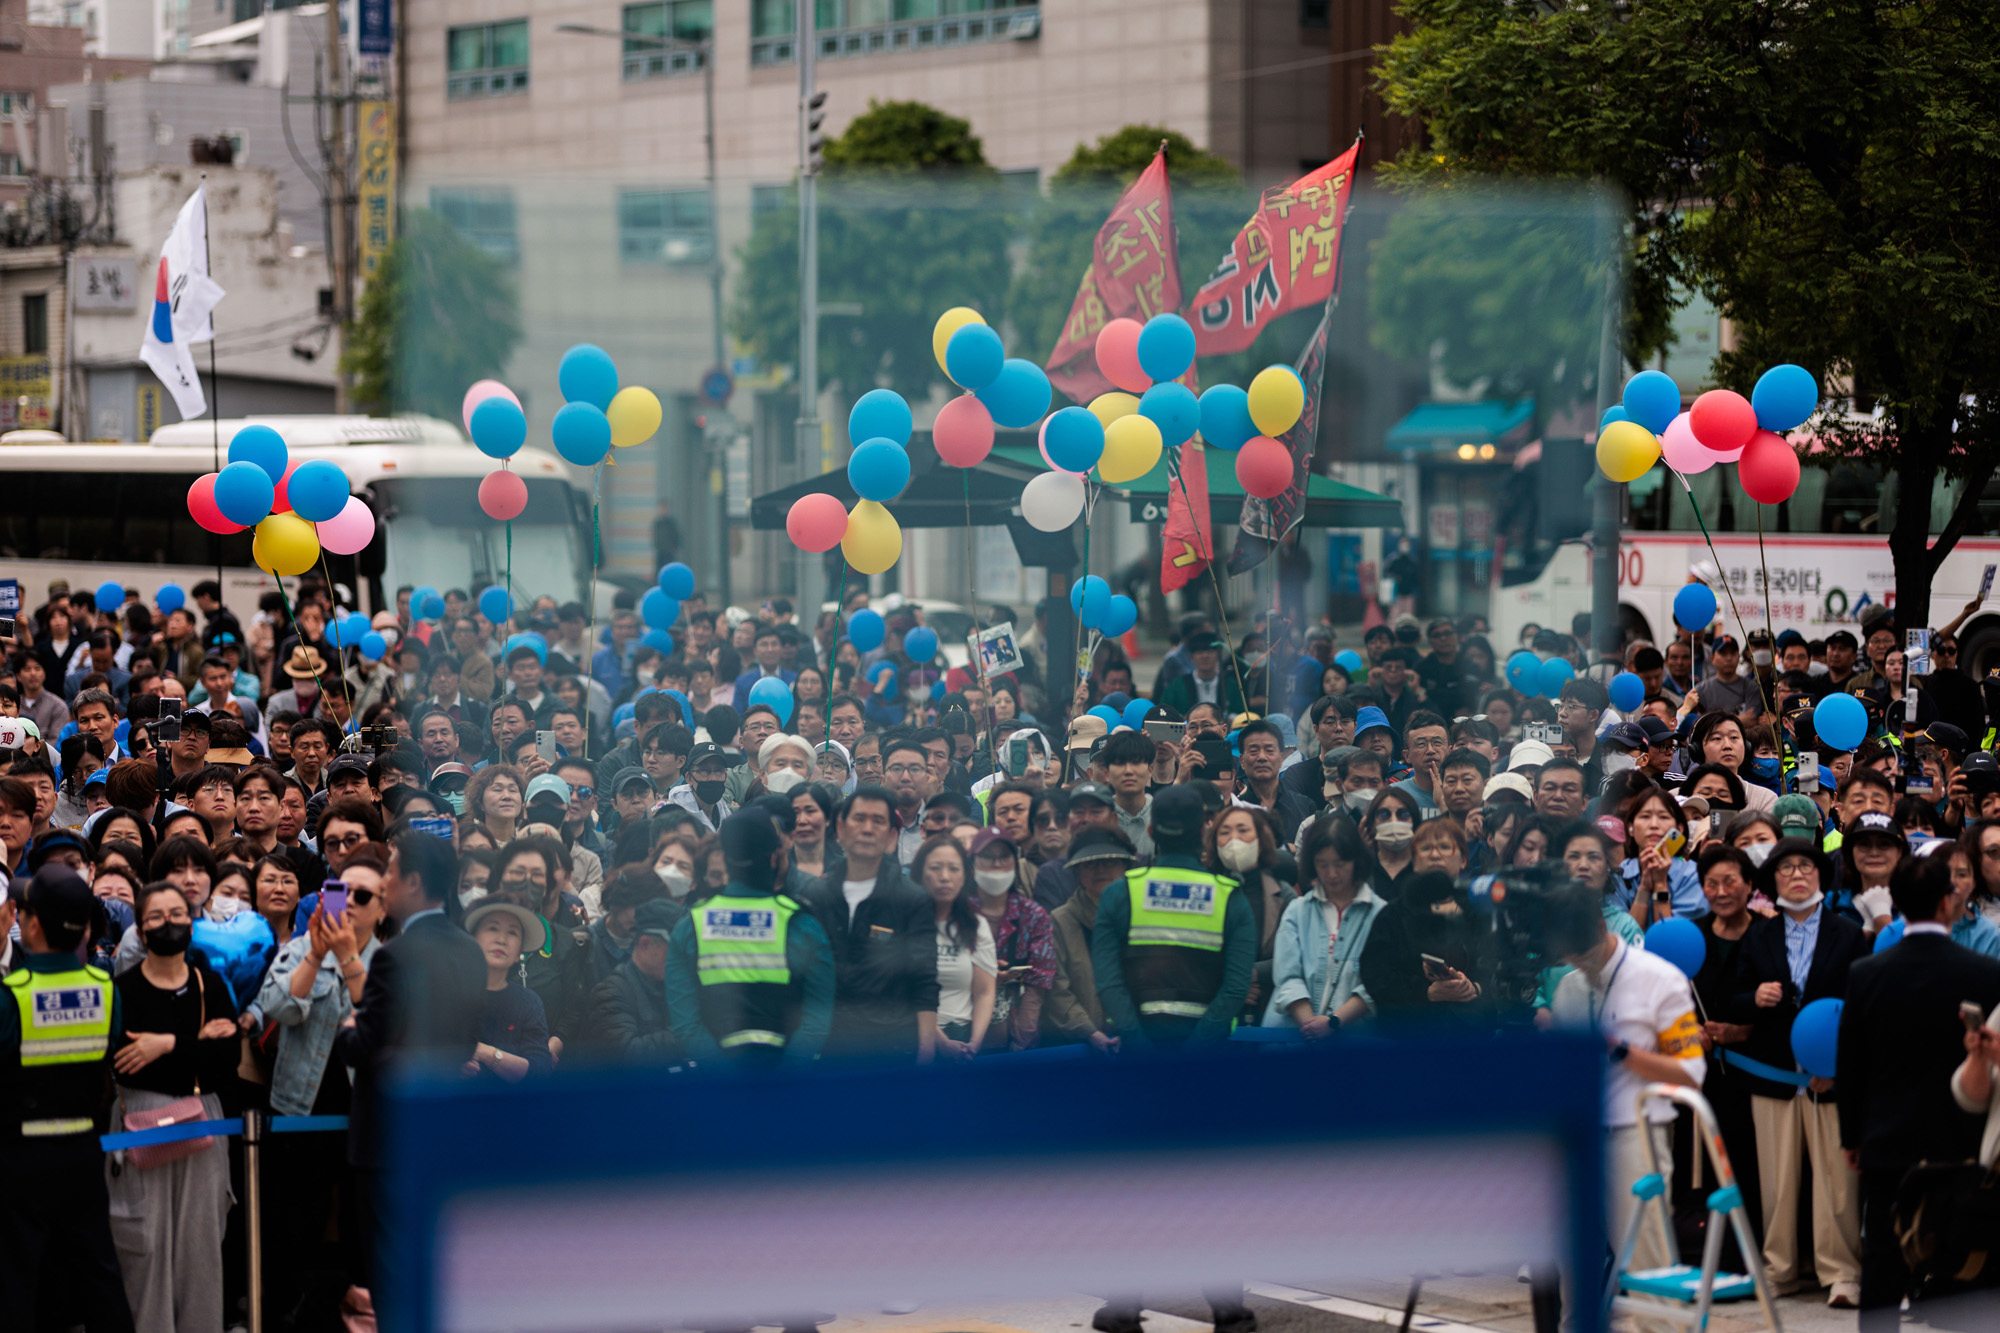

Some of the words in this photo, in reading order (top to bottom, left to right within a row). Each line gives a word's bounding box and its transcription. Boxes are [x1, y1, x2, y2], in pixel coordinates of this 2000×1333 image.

[1753, 567, 1821, 596] 한국이다
[1152, 899, 1206, 911] POLICE
[711, 927, 767, 938] POLICE
[41, 988, 95, 1011] 경찰
[42, 1009, 96, 1023] POLICE
